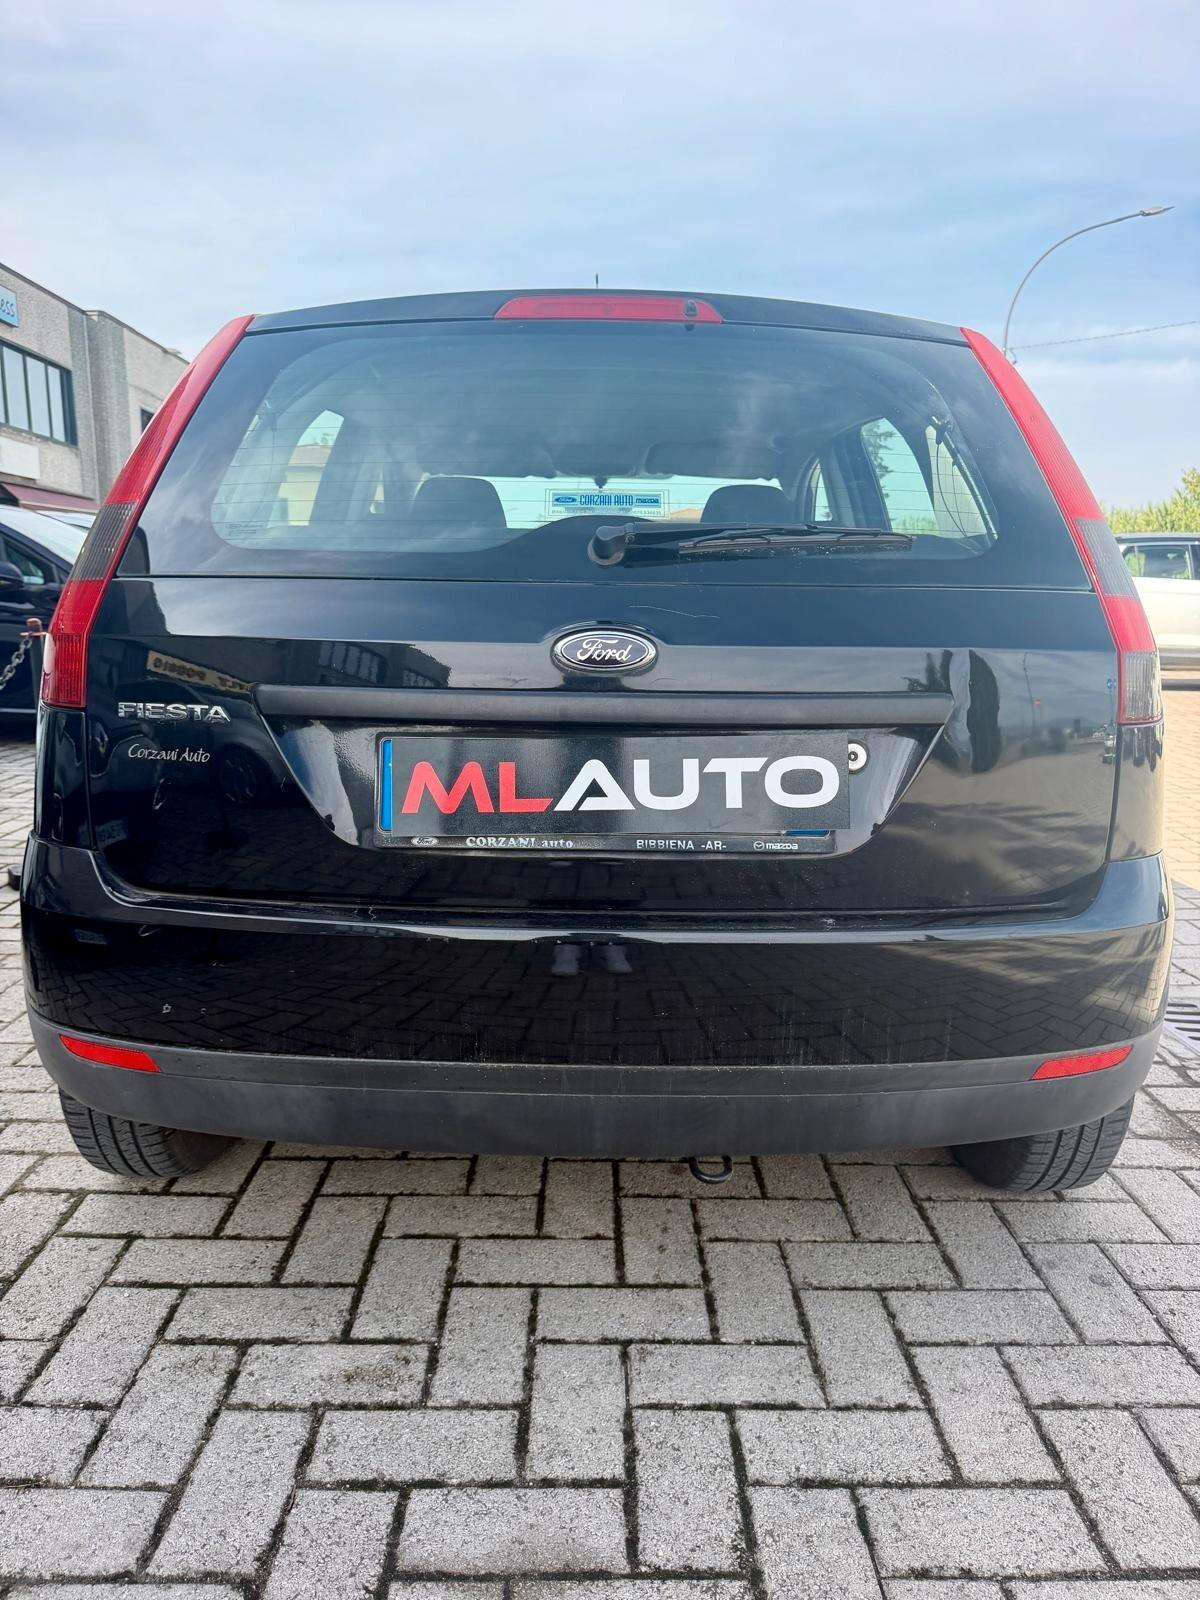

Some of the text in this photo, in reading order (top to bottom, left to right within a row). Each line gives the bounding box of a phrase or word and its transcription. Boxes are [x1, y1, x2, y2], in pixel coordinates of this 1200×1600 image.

[579, 494, 612, 507] CORZANI
[614, 494, 634, 507] AUTO
[576, 638, 633, 661] Ford
[118, 702, 231, 723] FIESTA
[128, 743, 211, 763] Corzani Auto
[466, 836, 574, 849] CORZANI auto
[636, 839, 727, 850] BIBBIENA -AR-
